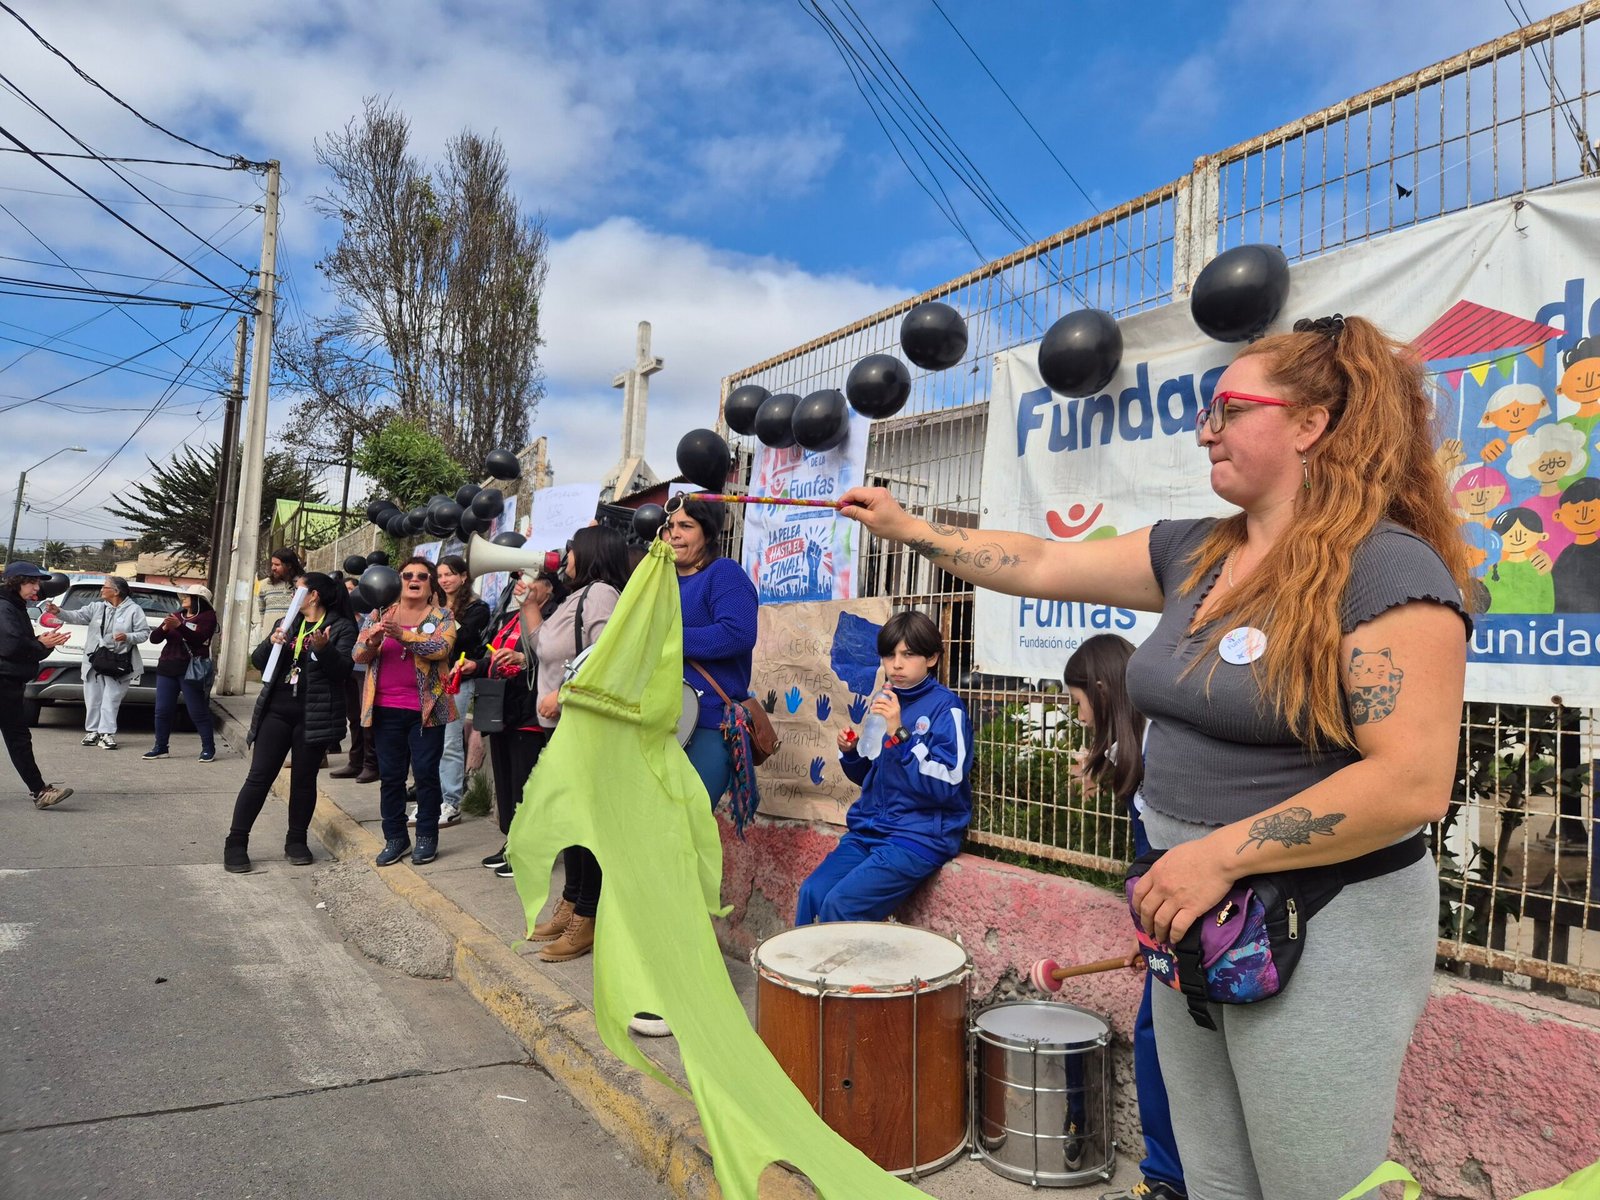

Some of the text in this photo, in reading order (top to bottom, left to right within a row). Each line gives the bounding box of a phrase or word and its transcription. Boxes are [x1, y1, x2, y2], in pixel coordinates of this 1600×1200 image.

[789, 474, 834, 499] Funfas
[768, 523, 801, 546] LA PELEA
[769, 540, 802, 563] HASTA EL
[769, 551, 806, 584] FINAL!
[1019, 635, 1078, 650] Fundación de
[1470, 618, 1600, 656] unida
